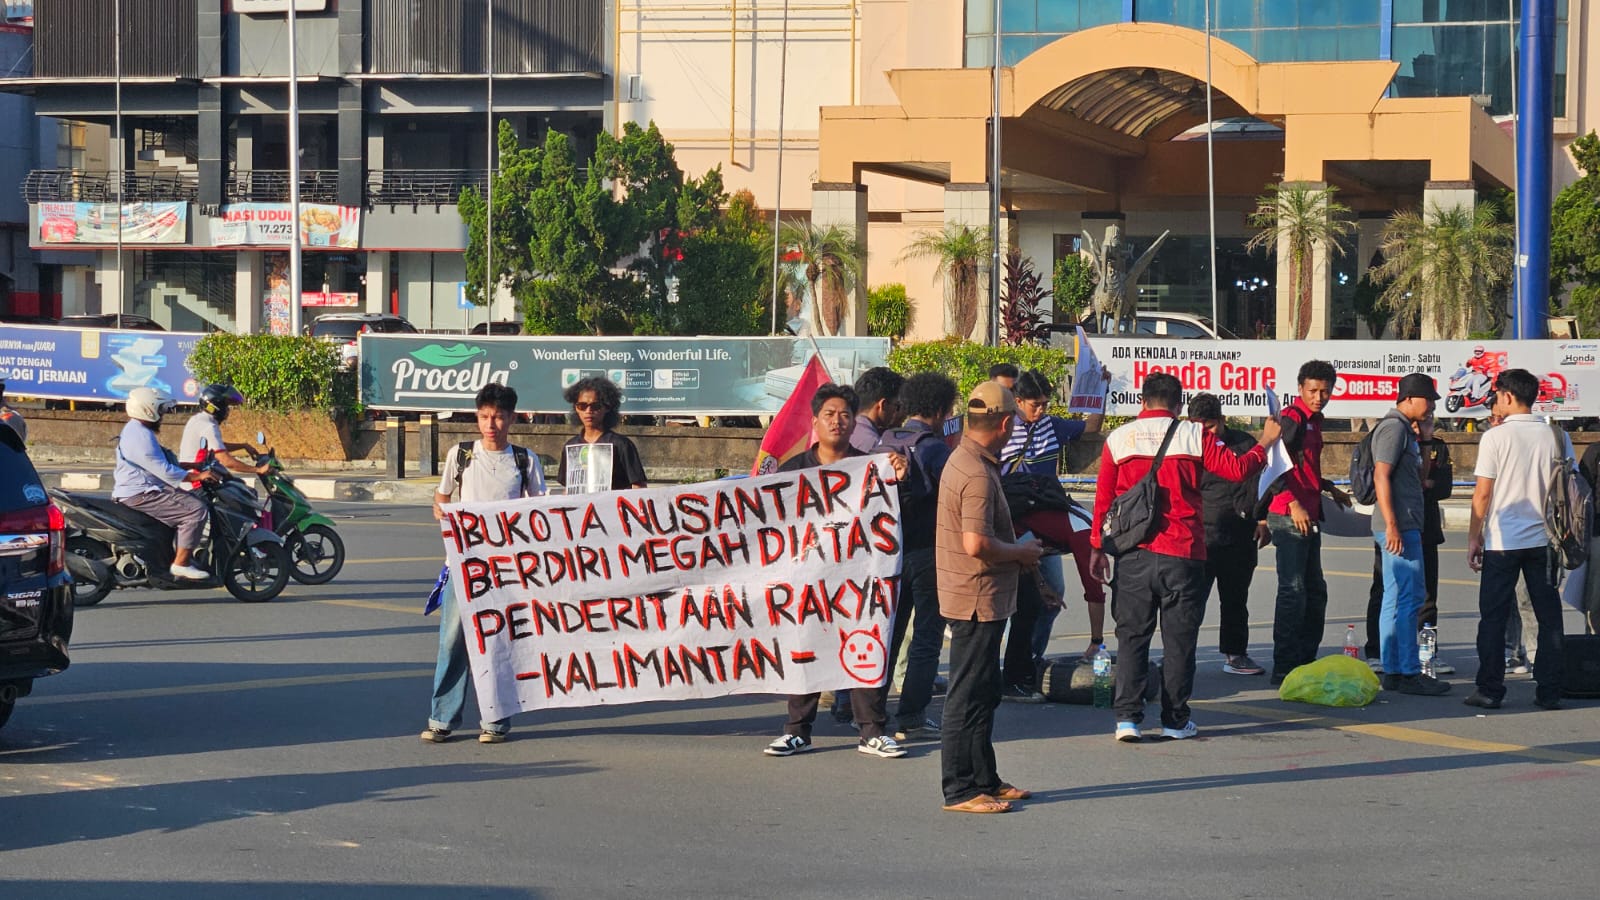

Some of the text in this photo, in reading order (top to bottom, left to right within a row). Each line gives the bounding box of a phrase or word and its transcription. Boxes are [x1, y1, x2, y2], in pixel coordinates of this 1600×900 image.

[223, 209, 255, 222] NASI
[532, 348, 732, 363] Wonderful Sleep, Wonderful Life.
[1112, 347, 1241, 361] ADA KENDALA DI PERJALANAN?
[1388, 353, 1410, 363] Senin
[1418, 353, 1441, 363] Sabtu
[1565, 354, 1595, 362] Honda
[17, 357, 52, 367] DENGAN
[1333, 359, 1381, 370] Operasional
[1426, 365, 1441, 373] WITA
[38, 369, 87, 384] JERMAN
[1219, 362, 1276, 391] Care
[1348, 381, 1399, 396] 0811-55-
[461, 512, 900, 602] BERDIRI MEGAH DIATAS
[7, 591, 42, 600] SIGRA
[473, 575, 900, 654] PENDERITAAN RAKYAT
